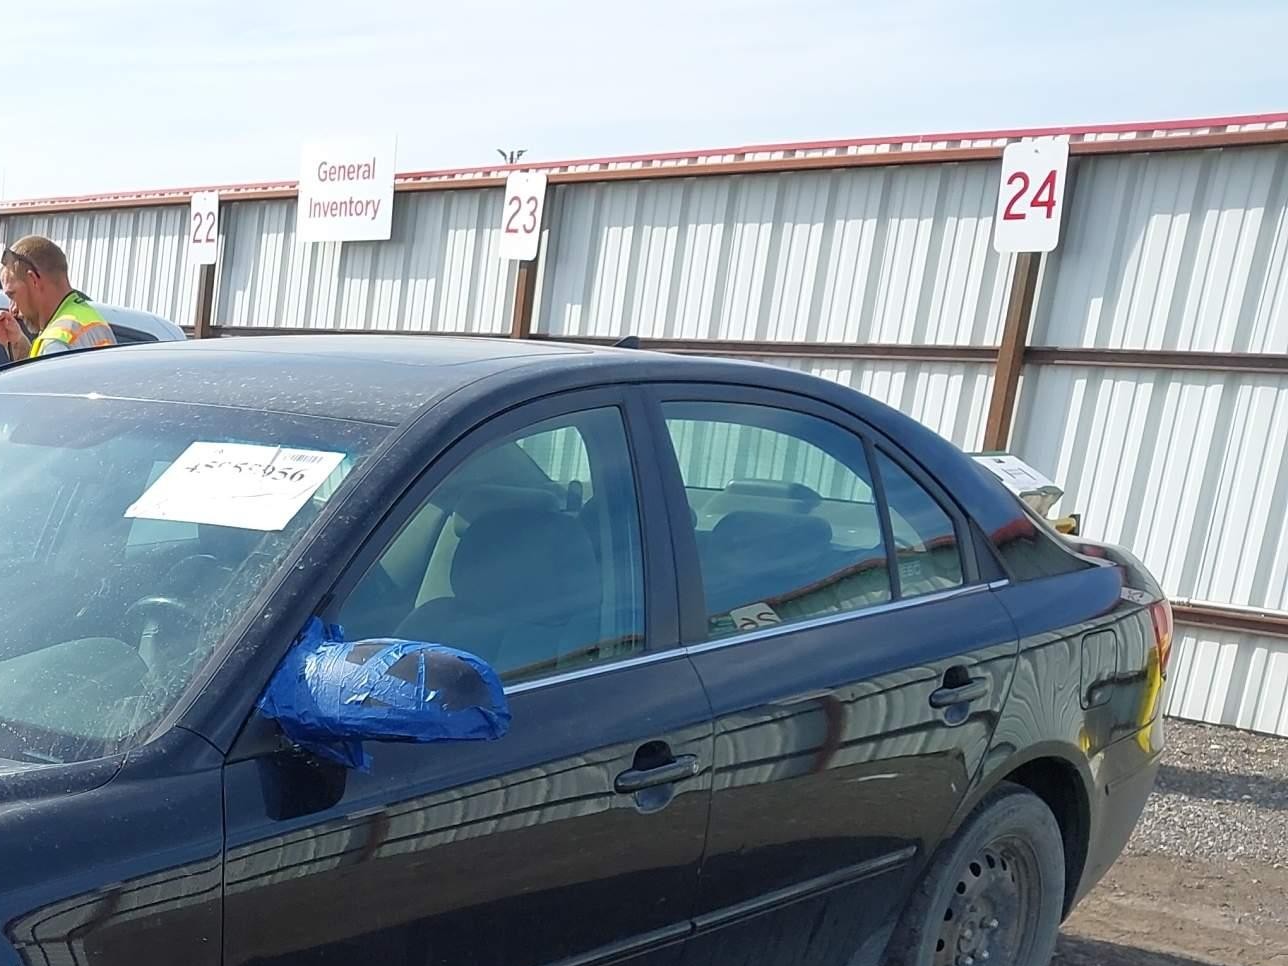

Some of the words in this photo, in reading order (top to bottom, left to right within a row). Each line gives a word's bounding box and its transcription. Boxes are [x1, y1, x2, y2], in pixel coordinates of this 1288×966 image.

[317, 156, 376, 182] General
[308, 196, 382, 221] Inventory
[1002, 169, 1058, 221] 24
[192, 211, 216, 243] 22
[505, 195, 539, 234] 23
